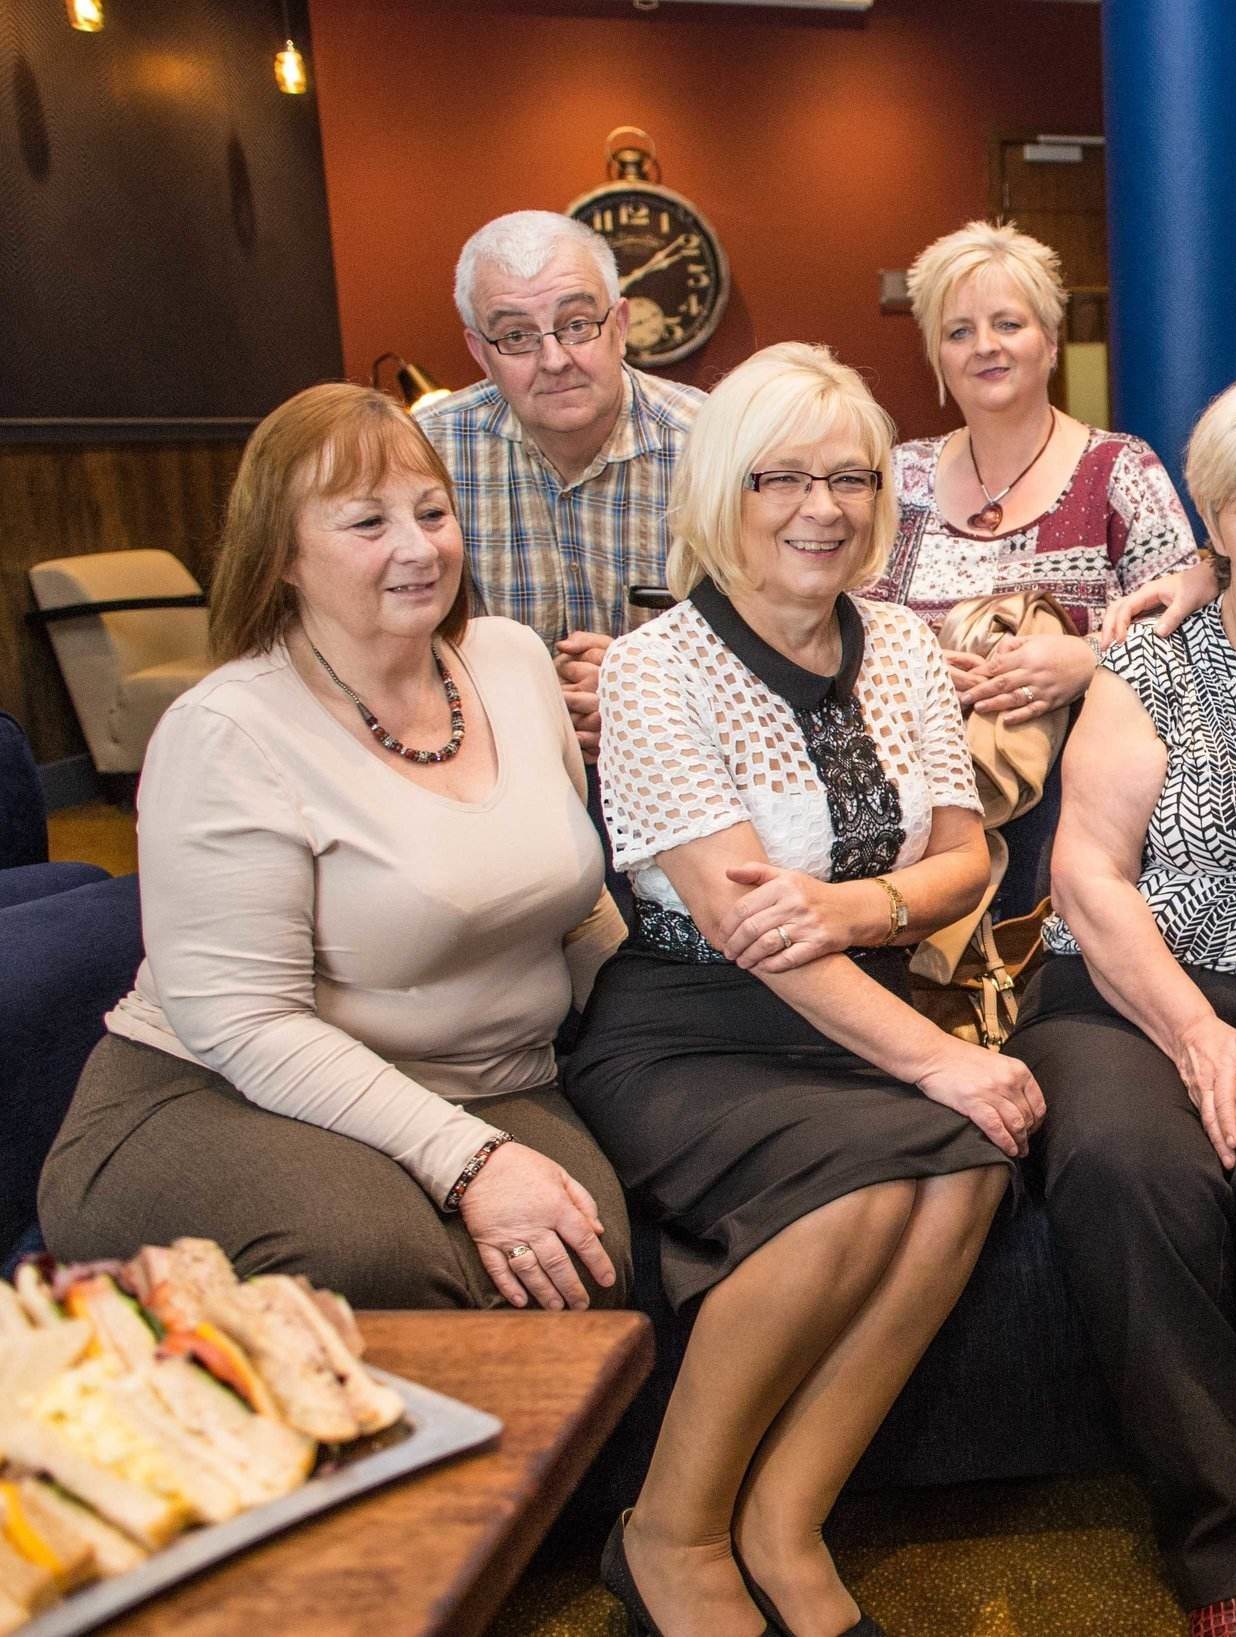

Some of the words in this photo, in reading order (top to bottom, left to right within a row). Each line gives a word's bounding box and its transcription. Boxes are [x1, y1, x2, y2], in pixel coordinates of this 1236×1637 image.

[619, 203, 650, 226] 12
[659, 211, 671, 235] 1
[679, 233, 702, 257] 2
[687, 263, 711, 289] 3
[678, 293, 705, 317] 4
